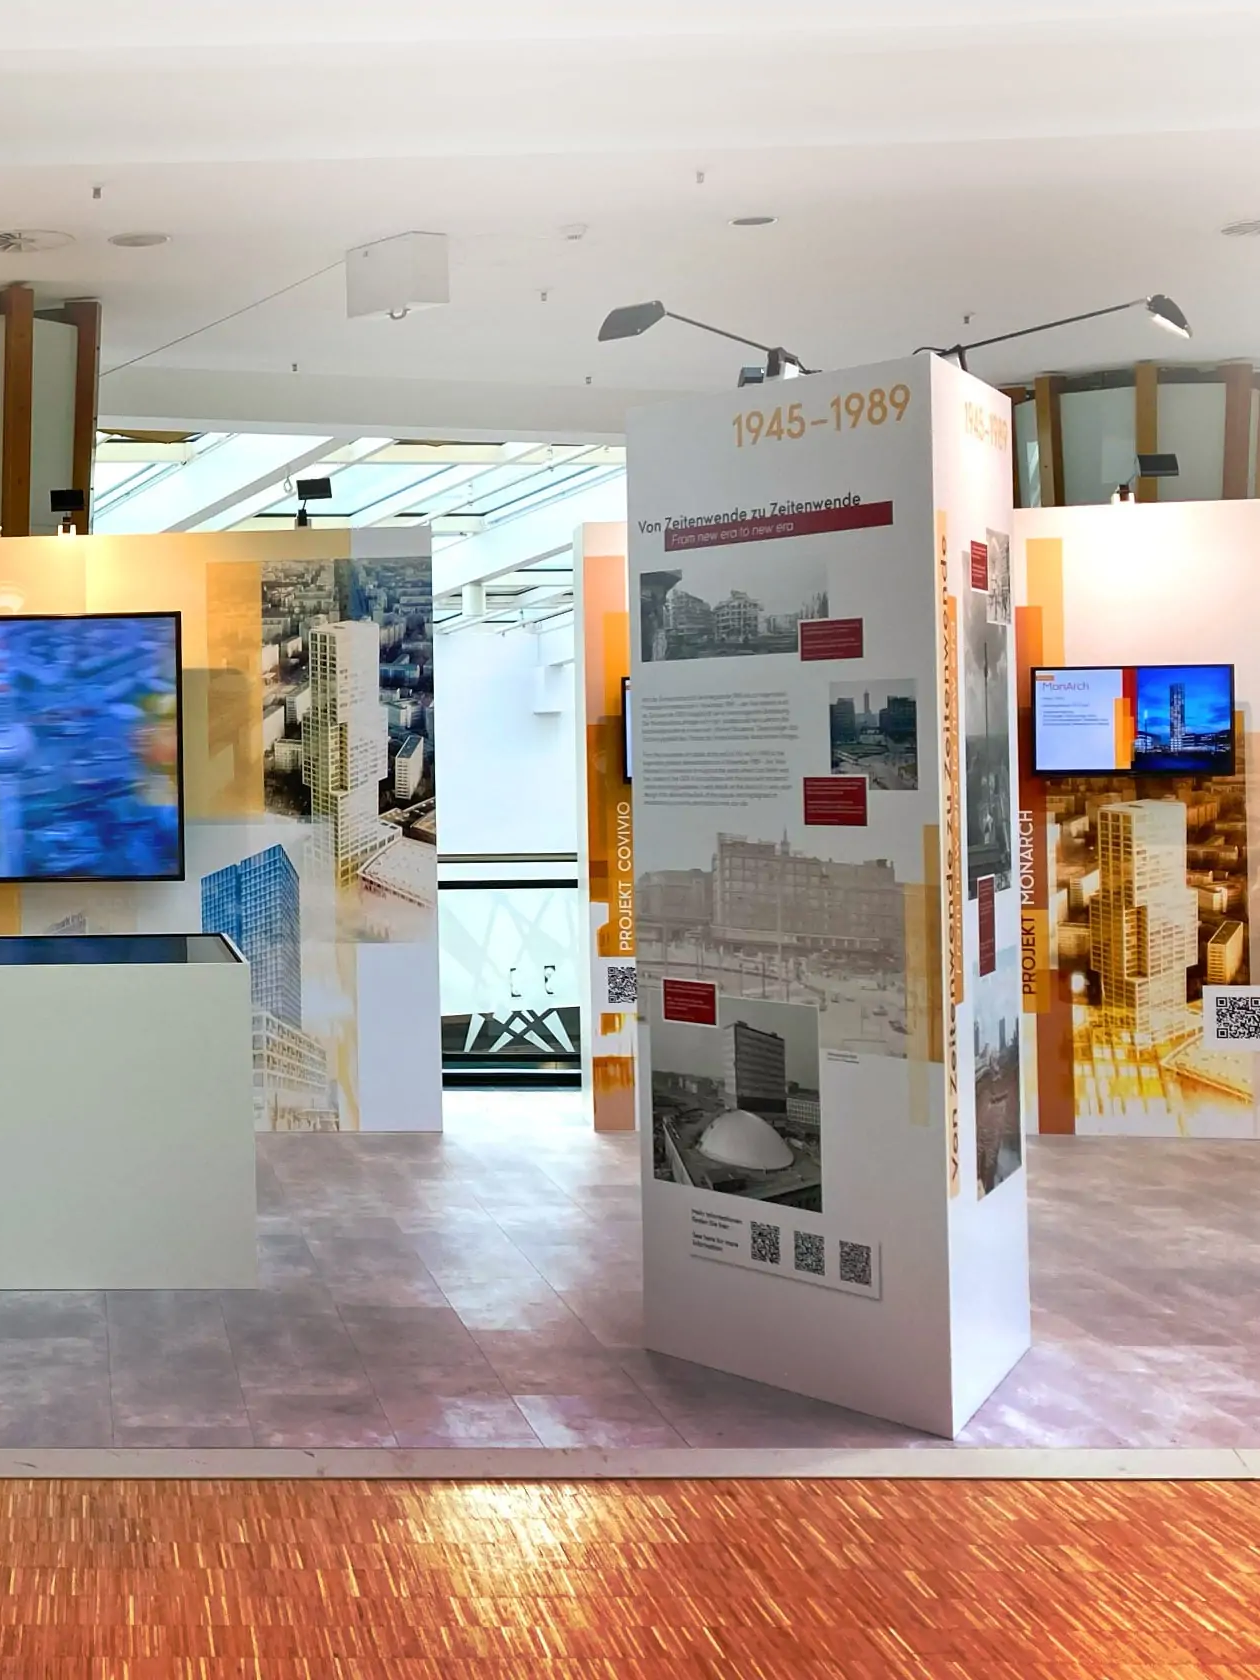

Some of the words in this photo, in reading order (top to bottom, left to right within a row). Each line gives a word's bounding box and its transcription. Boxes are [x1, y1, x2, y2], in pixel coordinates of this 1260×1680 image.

[638, 519, 662, 534] Von
[664, 507, 747, 530] Zeitenwende
[751, 506, 767, 518] zu
[770, 491, 861, 517] Zeitenwende
[671, 531, 696, 546] From
[697, 531, 718, 544] new
[720, 528, 737, 540] era
[740, 525, 750, 537] to
[751, 523, 774, 536] new
[775, 520, 794, 533] era
[940, 535, 952, 781] Zeitenwende
[1042, 682, 1090, 691] MonArch
[950, 676, 958, 735] new
[617, 801, 631, 872] COVIVIO
[944, 795, 953, 836] zu
[1018, 810, 1035, 905] MONARCH
[619, 881, 632, 951] PROJEKT
[945, 850, 958, 1094] Zeitenwende
[1021, 915, 1036, 995] PROJEKT
[950, 1108, 960, 1181] Von
